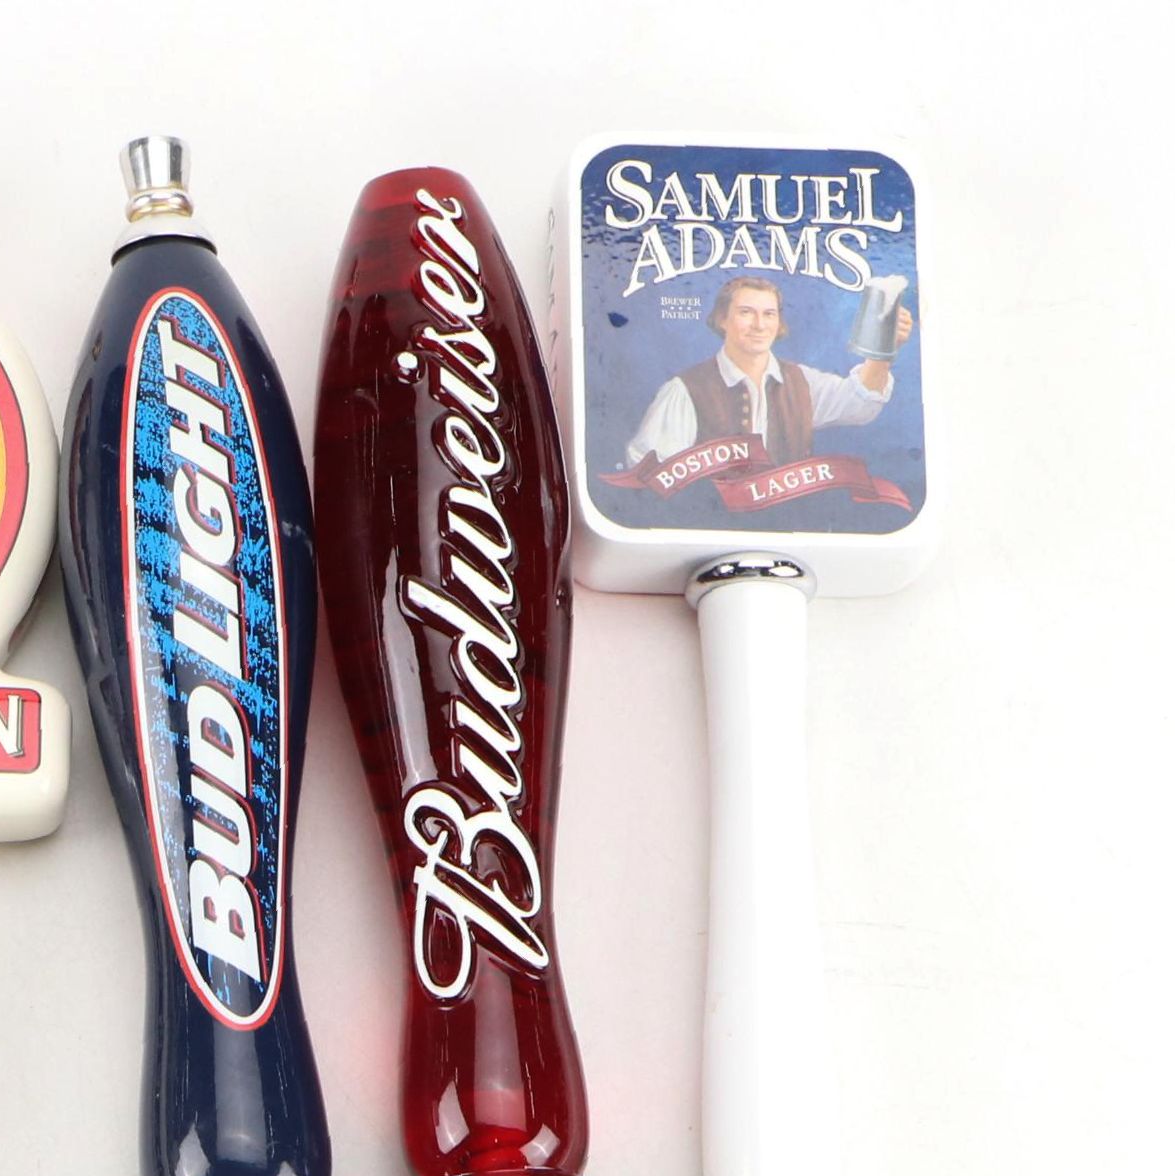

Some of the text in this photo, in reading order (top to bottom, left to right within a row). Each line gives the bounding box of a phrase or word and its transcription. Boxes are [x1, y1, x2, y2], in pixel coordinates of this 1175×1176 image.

[604, 159, 903, 233] SAMUEL
[623, 222, 873, 299] ADAMS
[656, 442, 750, 489] BOSTON
[748, 463, 834, 501] LAGER
[397, 188, 550, 999] Budweiser
[156, 315, 270, 983] BUD LIGHT
